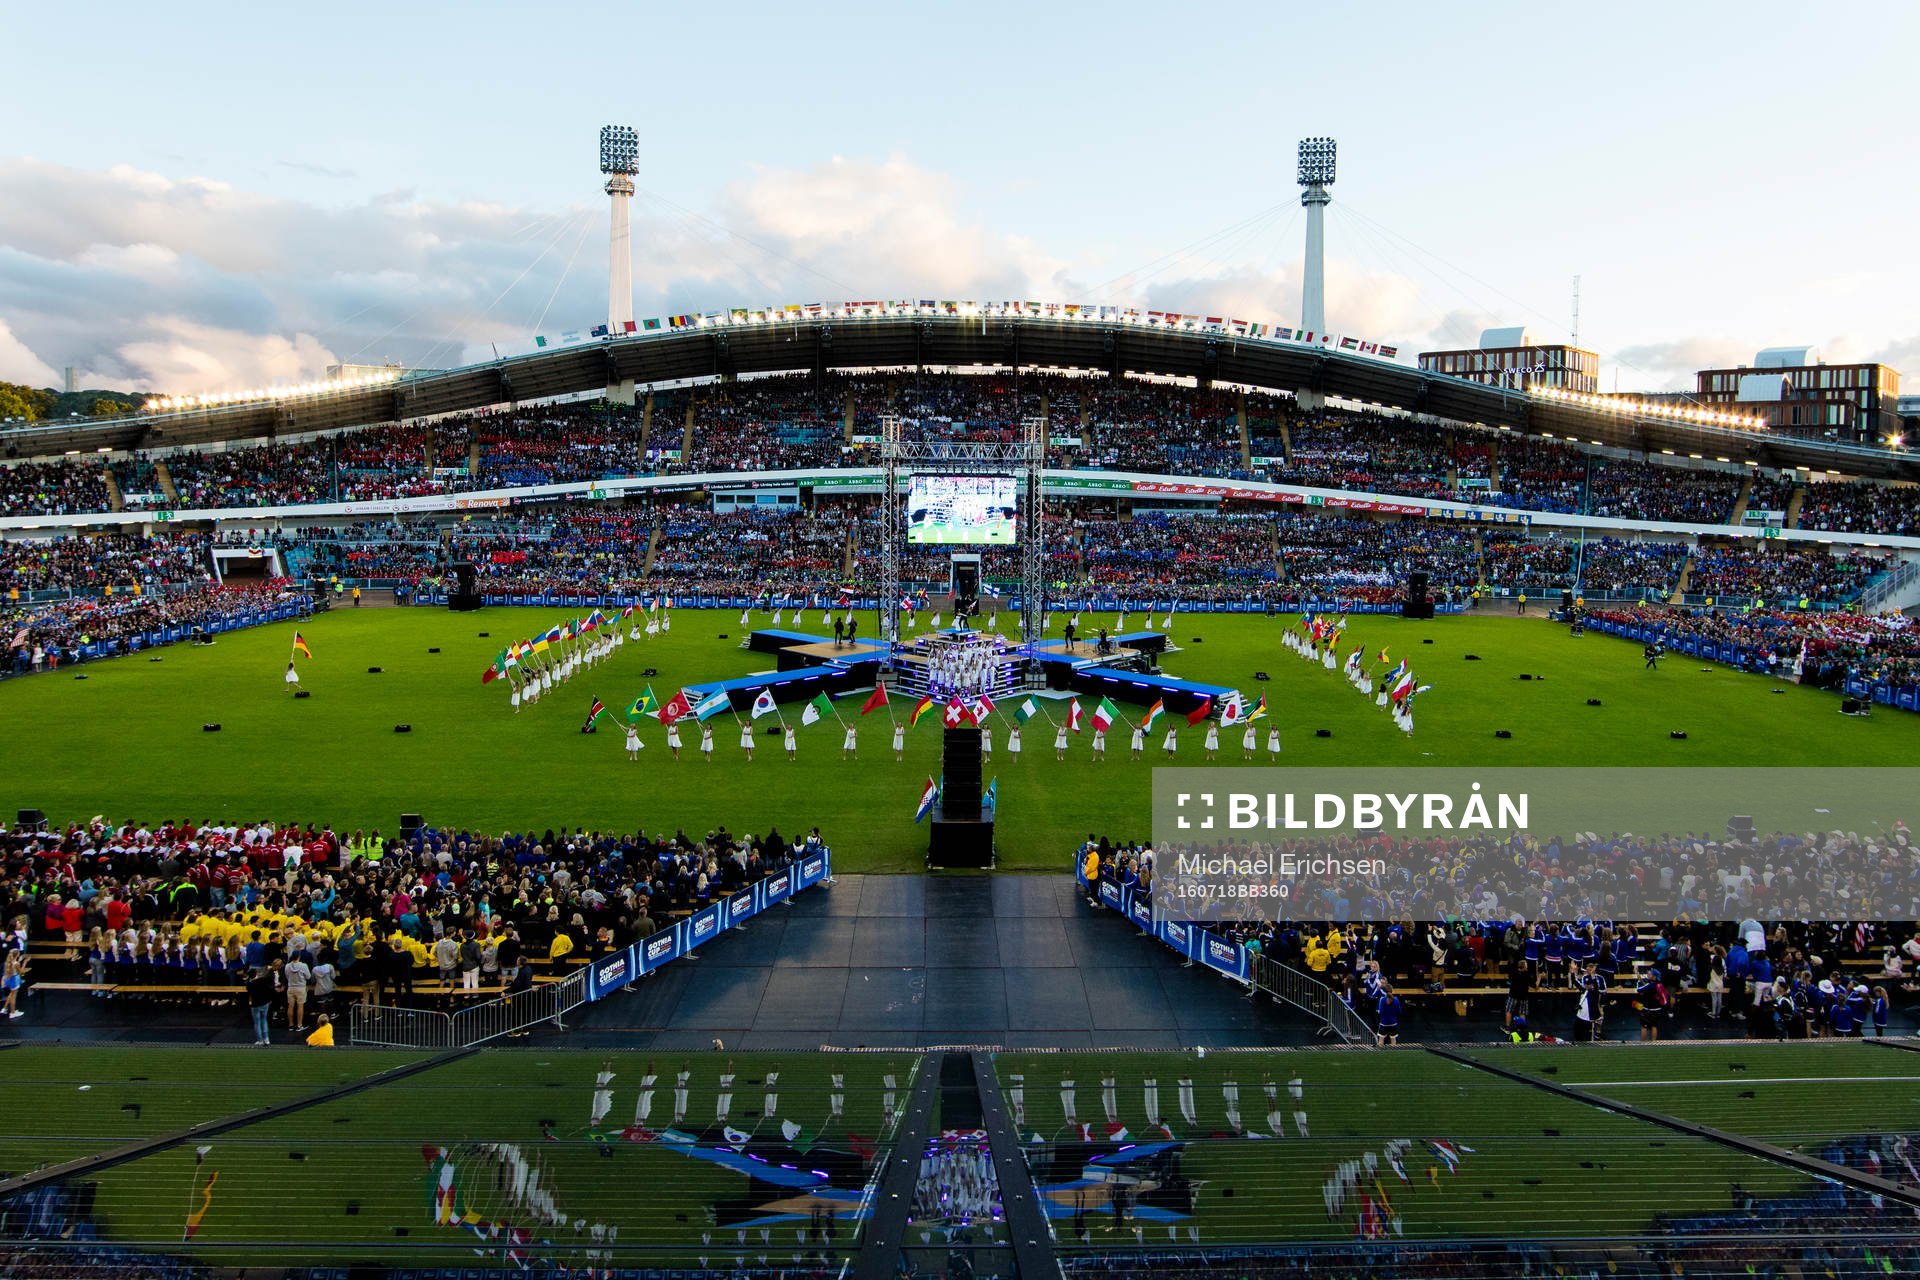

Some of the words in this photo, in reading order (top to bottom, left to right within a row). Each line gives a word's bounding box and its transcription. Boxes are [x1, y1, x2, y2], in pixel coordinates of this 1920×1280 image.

[468, 500, 498, 508] Renova
[769, 876, 788, 888] GOTHIA
[769, 885, 778, 895] CUP
[732, 894, 751, 908] GOTHIA
[732, 905, 742, 914] CUP
[695, 914, 714, 928] GOTHIA
[695, 924, 704, 934] CUP
[648, 936, 672, 951] GOTHIA
[1210, 940, 1235, 955] GOTHIA
[648, 948, 660, 957] CUP
[1210, 946, 1223, 956] CUP
[600, 958, 625, 976] GOTHIA
[600, 972, 612, 983] CUP
